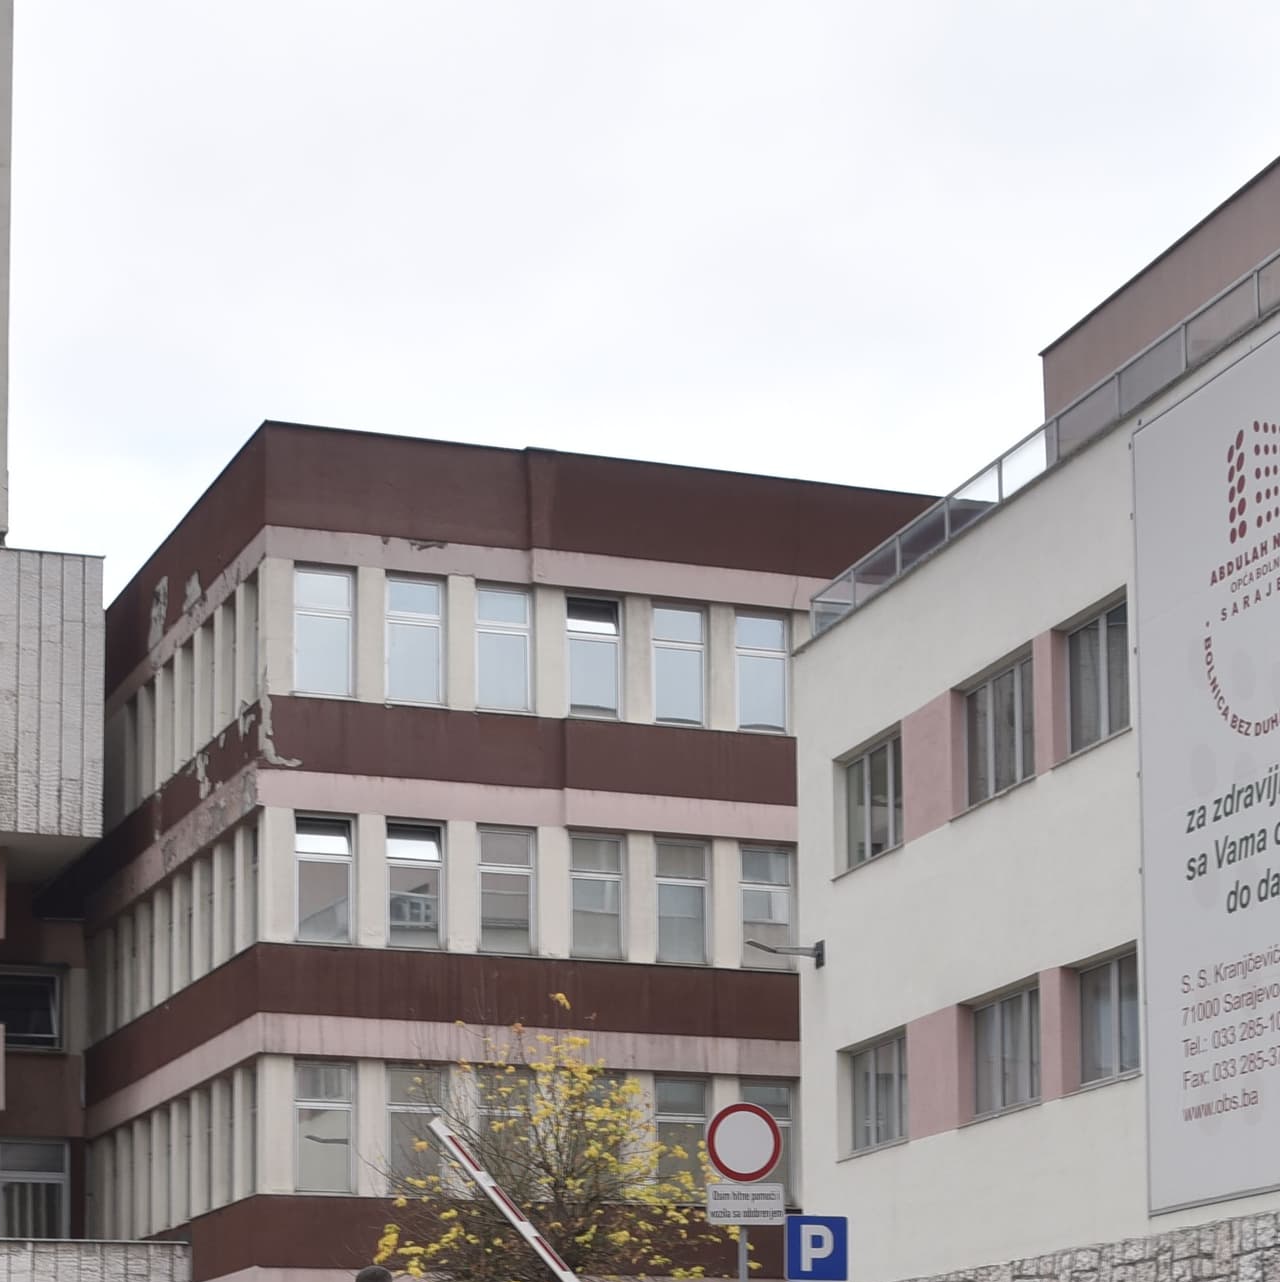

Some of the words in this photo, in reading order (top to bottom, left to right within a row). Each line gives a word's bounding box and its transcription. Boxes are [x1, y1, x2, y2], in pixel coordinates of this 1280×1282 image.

[1209, 539, 1269, 587] ABDULAH
[1204, 636, 1230, 721] BOLNICA
[1230, 713, 1252, 737] BEZ
[1186, 804, 1207, 834] za
[1186, 852, 1208, 881] sa
[1214, 827, 1267, 869] Vama
[1226, 879, 1251, 914] do
[1181, 974, 1195, 994] S.
[1197, 968, 1211, 989] S.
[1181, 997, 1220, 1026] 71000
[1223, 982, 1280, 1014] Sarajevo
[1210, 1025, 1237, 1050] 033
[1211, 1057, 1237, 1083] 033
[1182, 1088, 1260, 1122] www.obs.ba
[799, 1224, 835, 1272] P
